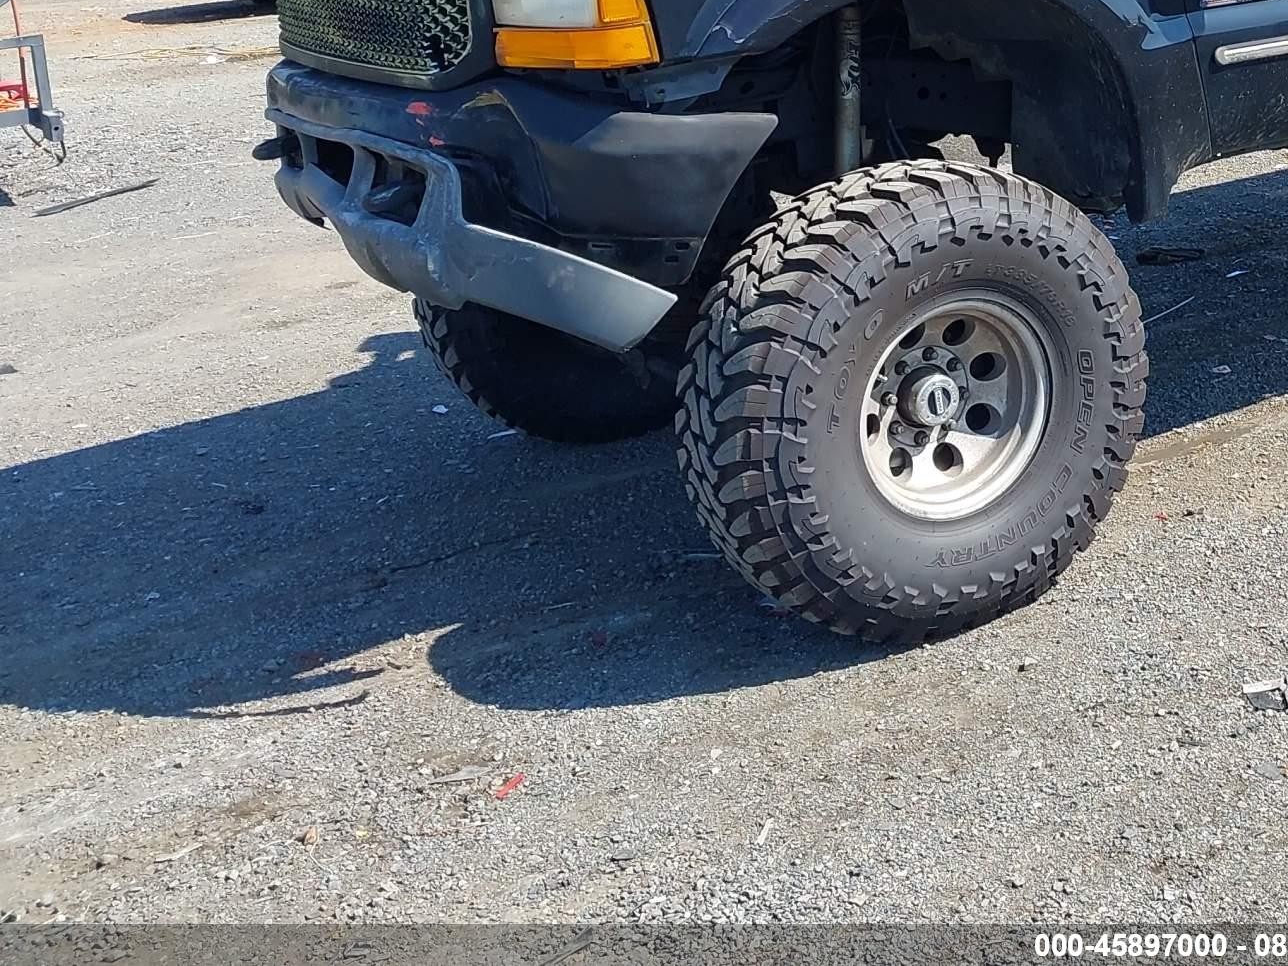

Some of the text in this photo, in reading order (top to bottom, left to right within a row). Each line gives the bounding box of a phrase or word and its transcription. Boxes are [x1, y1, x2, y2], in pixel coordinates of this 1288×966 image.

[905, 258, 976, 302] M/T
[826, 307, 885, 435] TOYO
[922, 348, 1097, 568] OPEN COUNTRY
